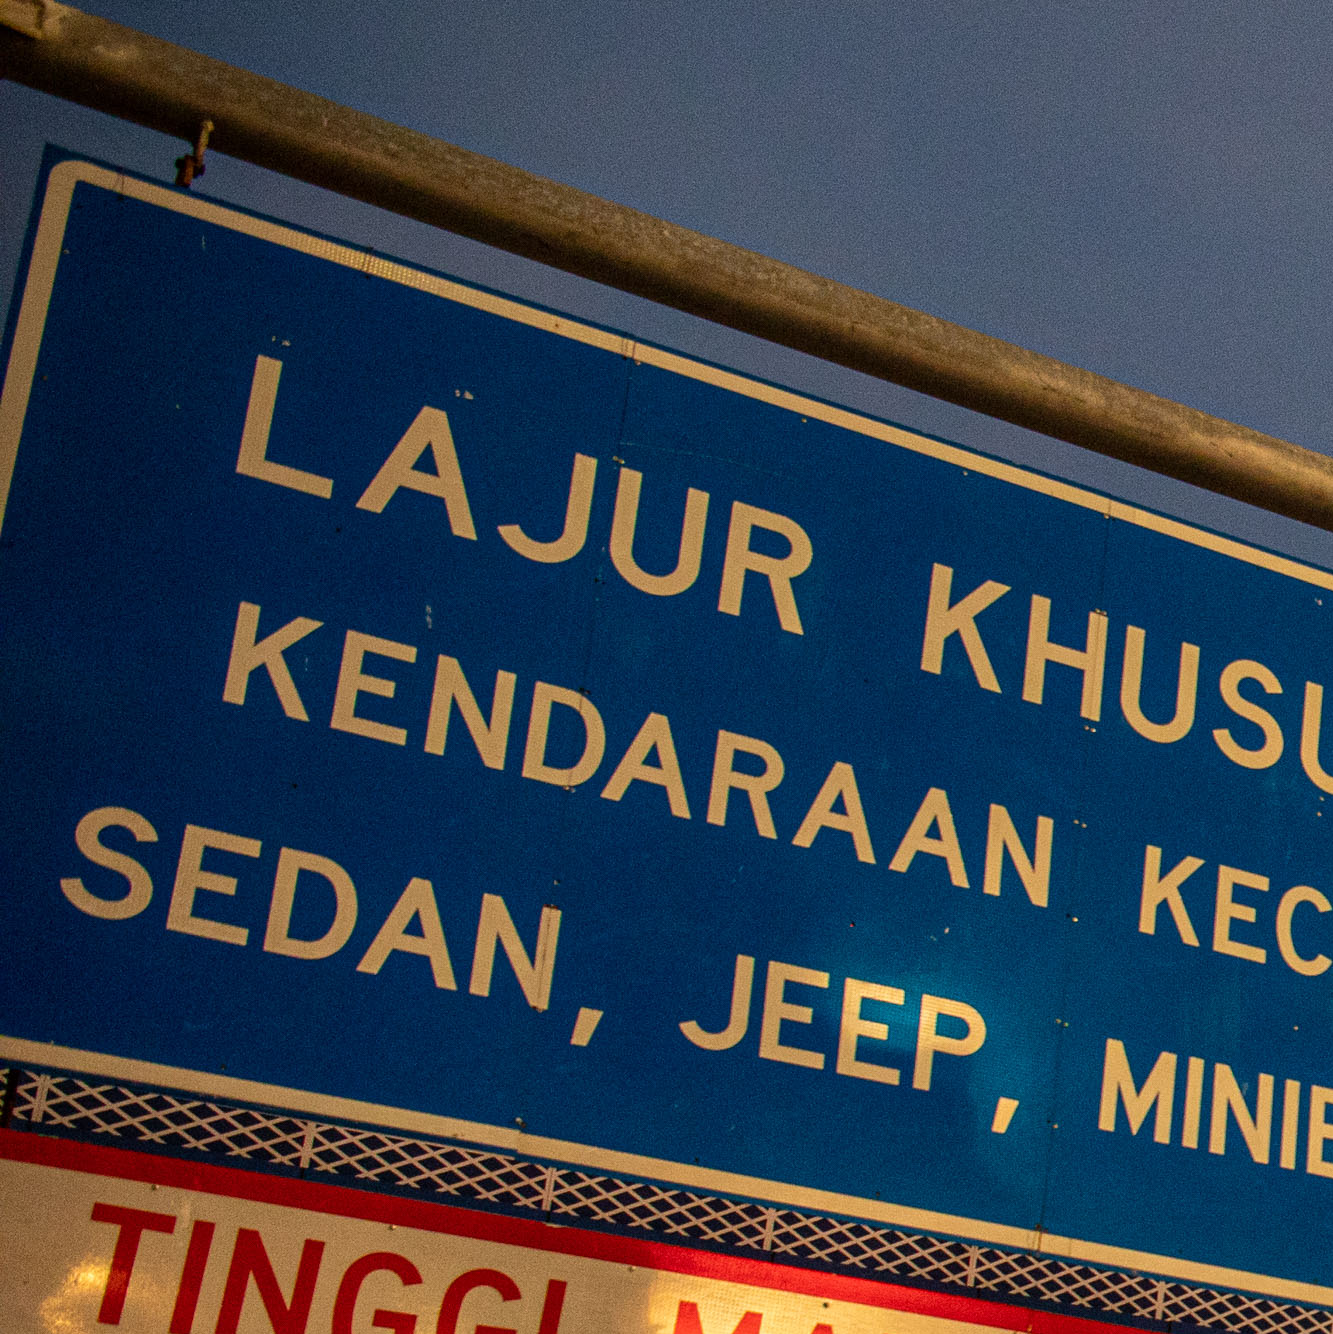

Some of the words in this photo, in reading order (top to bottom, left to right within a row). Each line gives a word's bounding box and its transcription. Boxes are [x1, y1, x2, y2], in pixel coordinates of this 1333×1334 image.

[235, 354, 814, 636] LAJUR
[222, 600, 1054, 908] KENDARAAN
[59, 806, 604, 1046] SEDAN,
[679, 954, 1020, 1135] JEEP,
